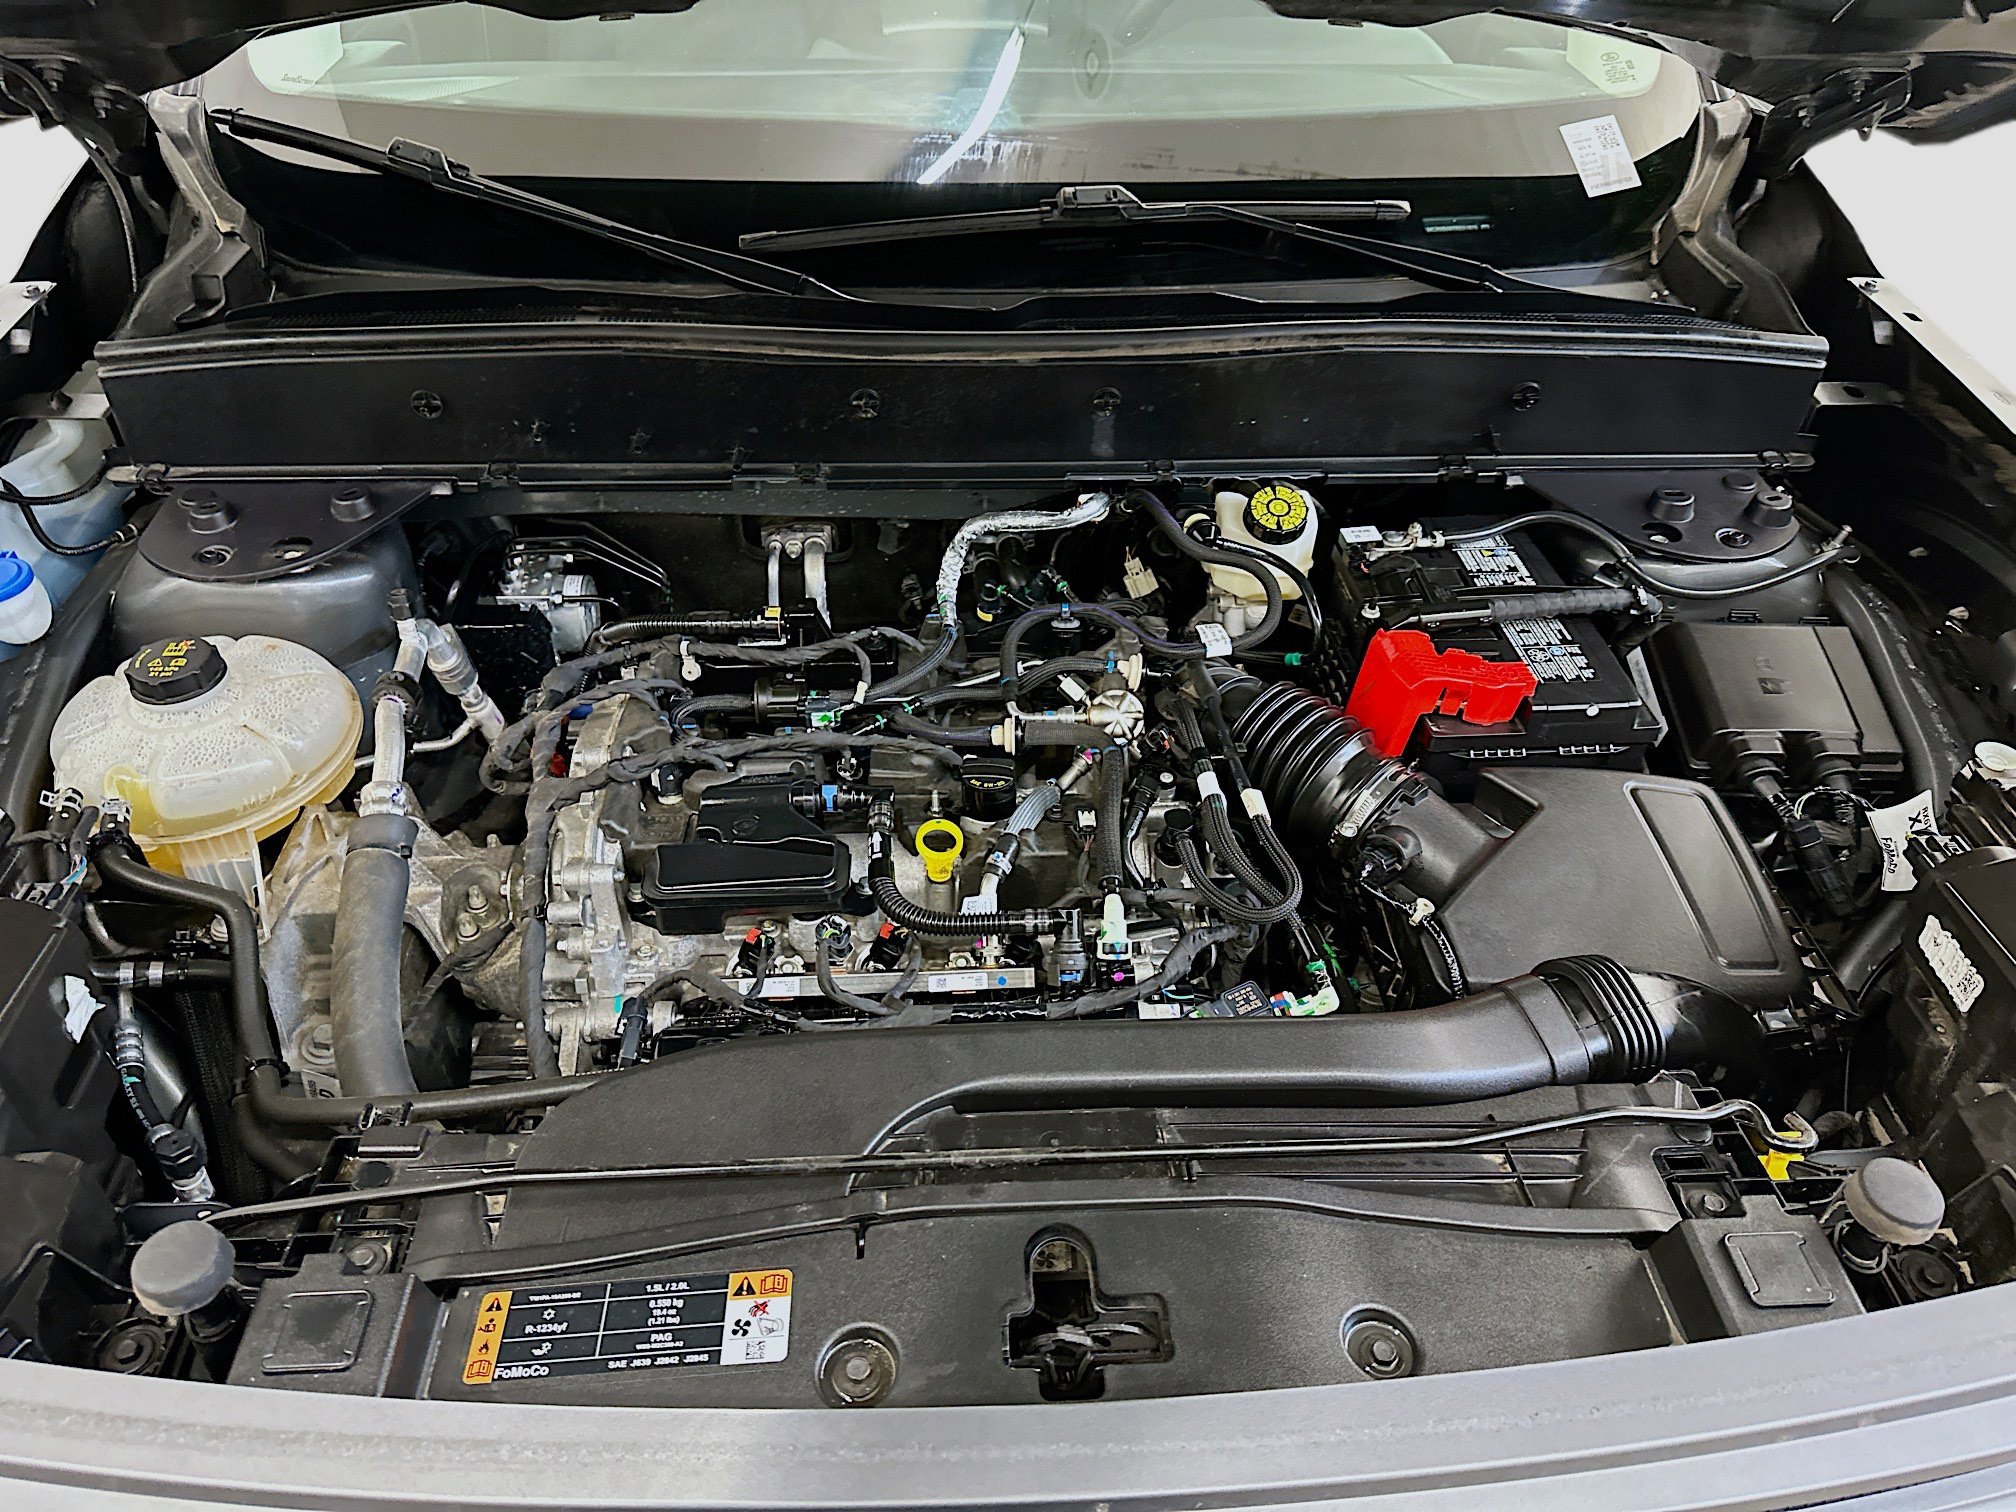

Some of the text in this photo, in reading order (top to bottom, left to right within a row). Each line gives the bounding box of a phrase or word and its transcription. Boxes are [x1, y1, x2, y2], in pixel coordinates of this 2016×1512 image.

[645, 1283, 665, 1293] 1.5L
[670, 1281, 690, 1291] 2.0L
[672, 1297, 685, 1309] kg
[524, 1321, 569, 1335] R-1234yf
[650, 1332, 673, 1342] PAG
[607, 1359, 628, 1369] SAE
[493, 1364, 550, 1380] FoMoCo
